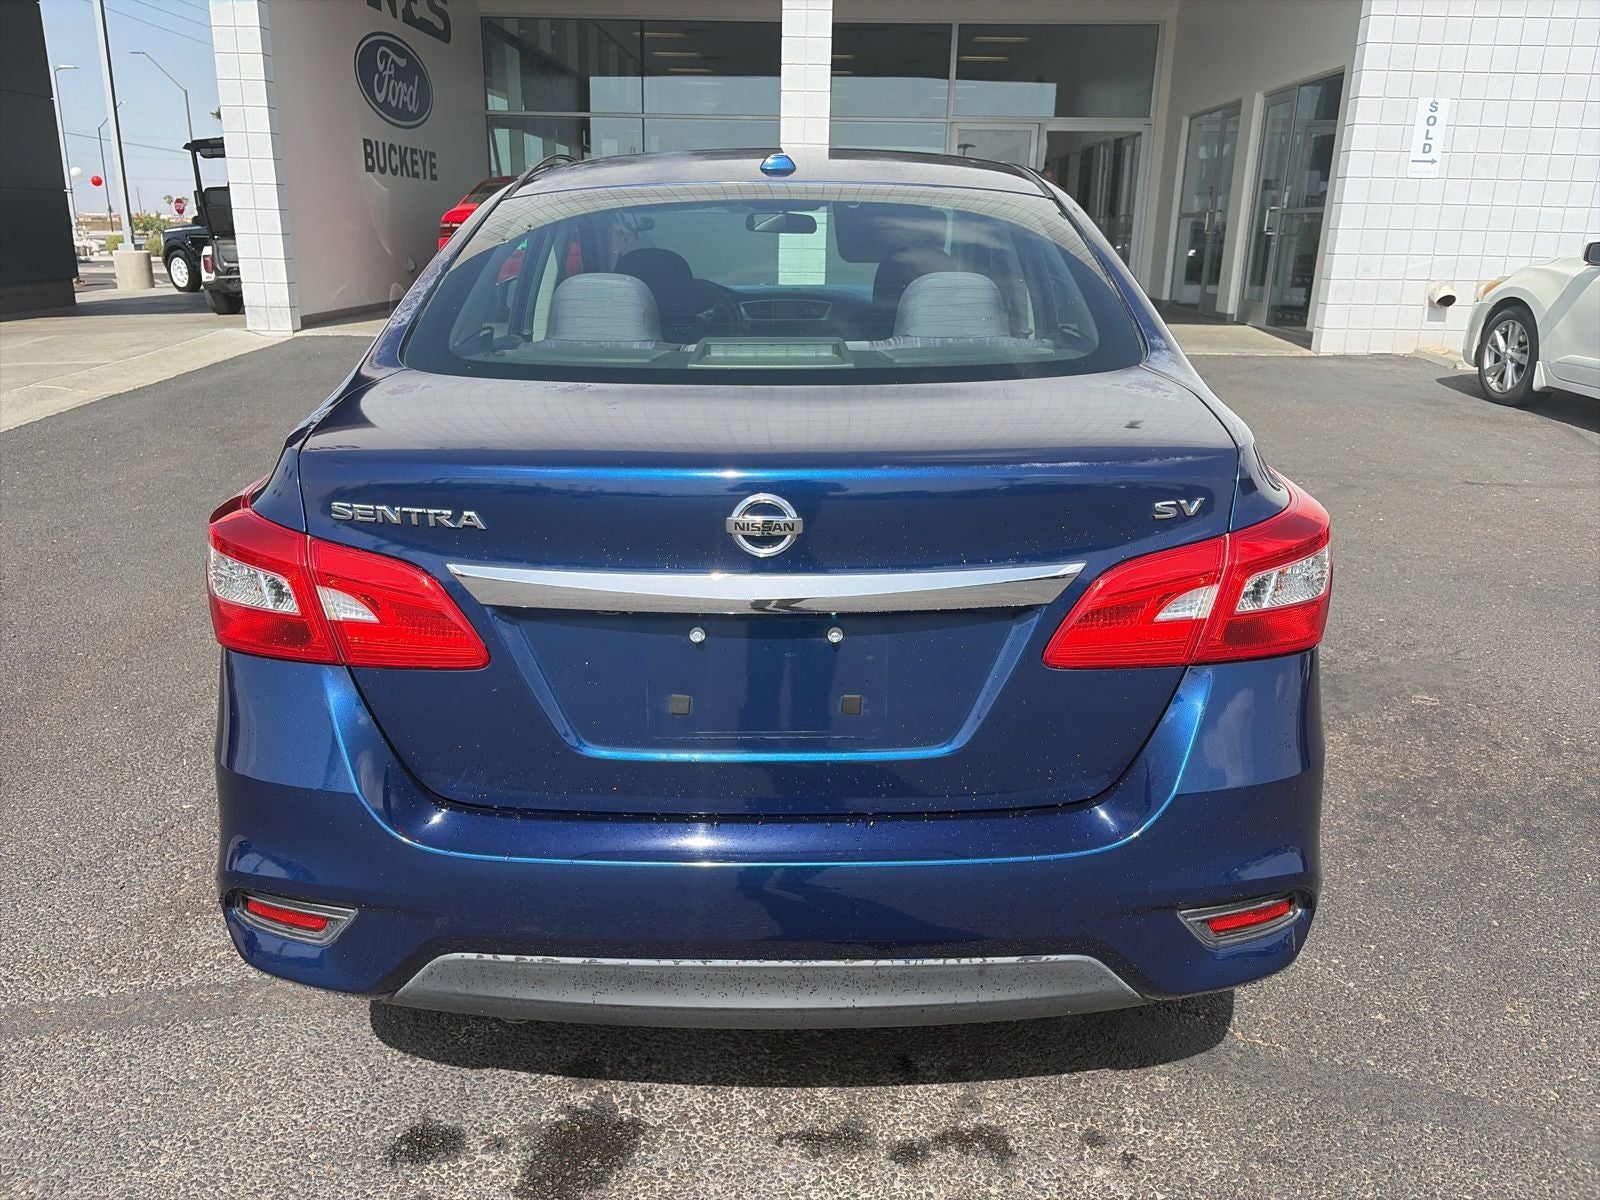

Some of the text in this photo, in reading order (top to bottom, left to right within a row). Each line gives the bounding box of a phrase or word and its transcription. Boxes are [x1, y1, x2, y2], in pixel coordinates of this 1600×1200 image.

[374, 46, 420, 113] Ford
[1422, 101, 1439, 154] SOLD
[363, 138, 438, 181] BUCKEYE
[331, 502, 487, 530] SENTRA
[1152, 497, 1206, 520] SV
[734, 521, 795, 532] NISSAN
